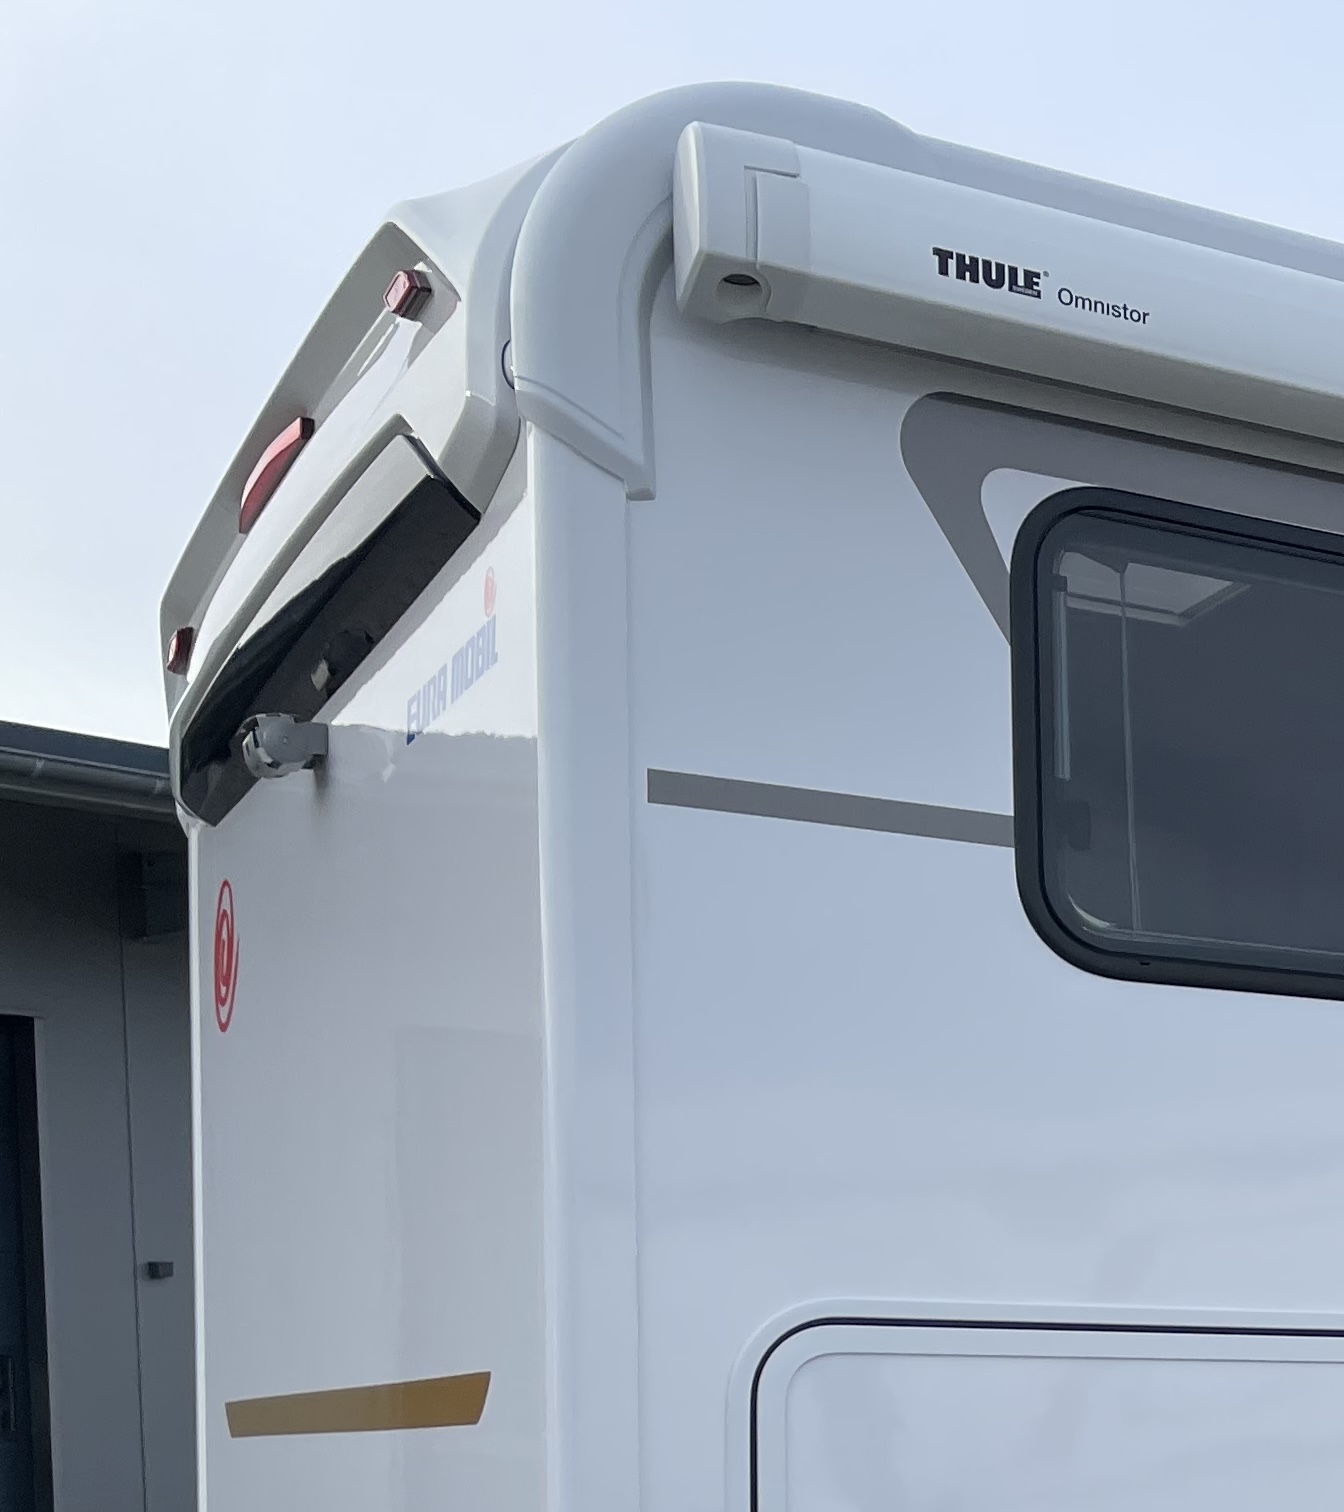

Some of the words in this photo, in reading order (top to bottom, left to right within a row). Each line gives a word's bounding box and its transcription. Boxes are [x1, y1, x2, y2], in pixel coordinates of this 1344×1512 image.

[932, 246, 1042, 300] THULE
[1057, 287, 1151, 325] Omnistor
[406, 662, 448, 746] EURA
[450, 612, 499, 705] MOBIL
